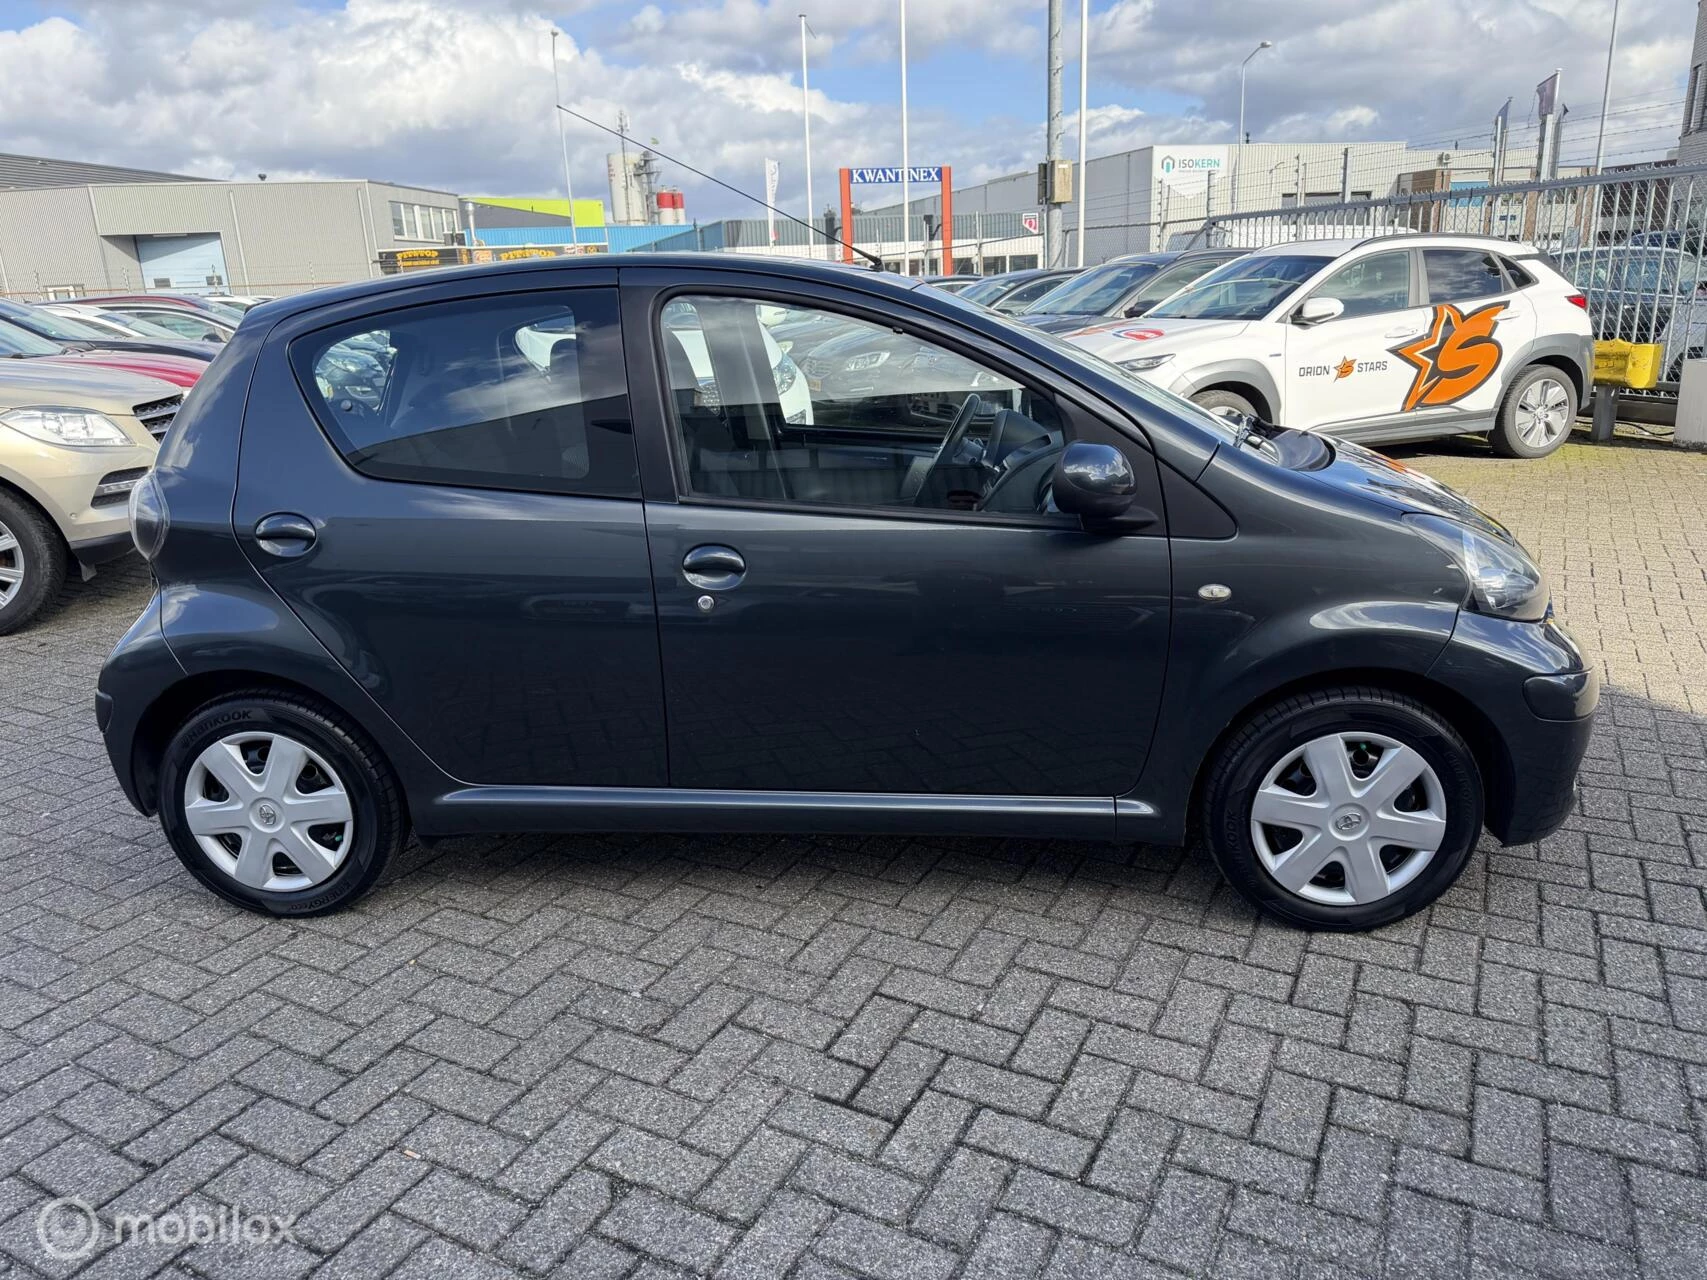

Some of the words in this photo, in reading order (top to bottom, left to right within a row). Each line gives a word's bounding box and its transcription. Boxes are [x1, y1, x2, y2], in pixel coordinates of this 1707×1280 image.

[1178, 158, 1221, 169] ISOKERN
[852, 167, 939, 183] KWANTNEX
[1298, 365, 1331, 377] ORION
[1357, 360, 1388, 373] STARS
